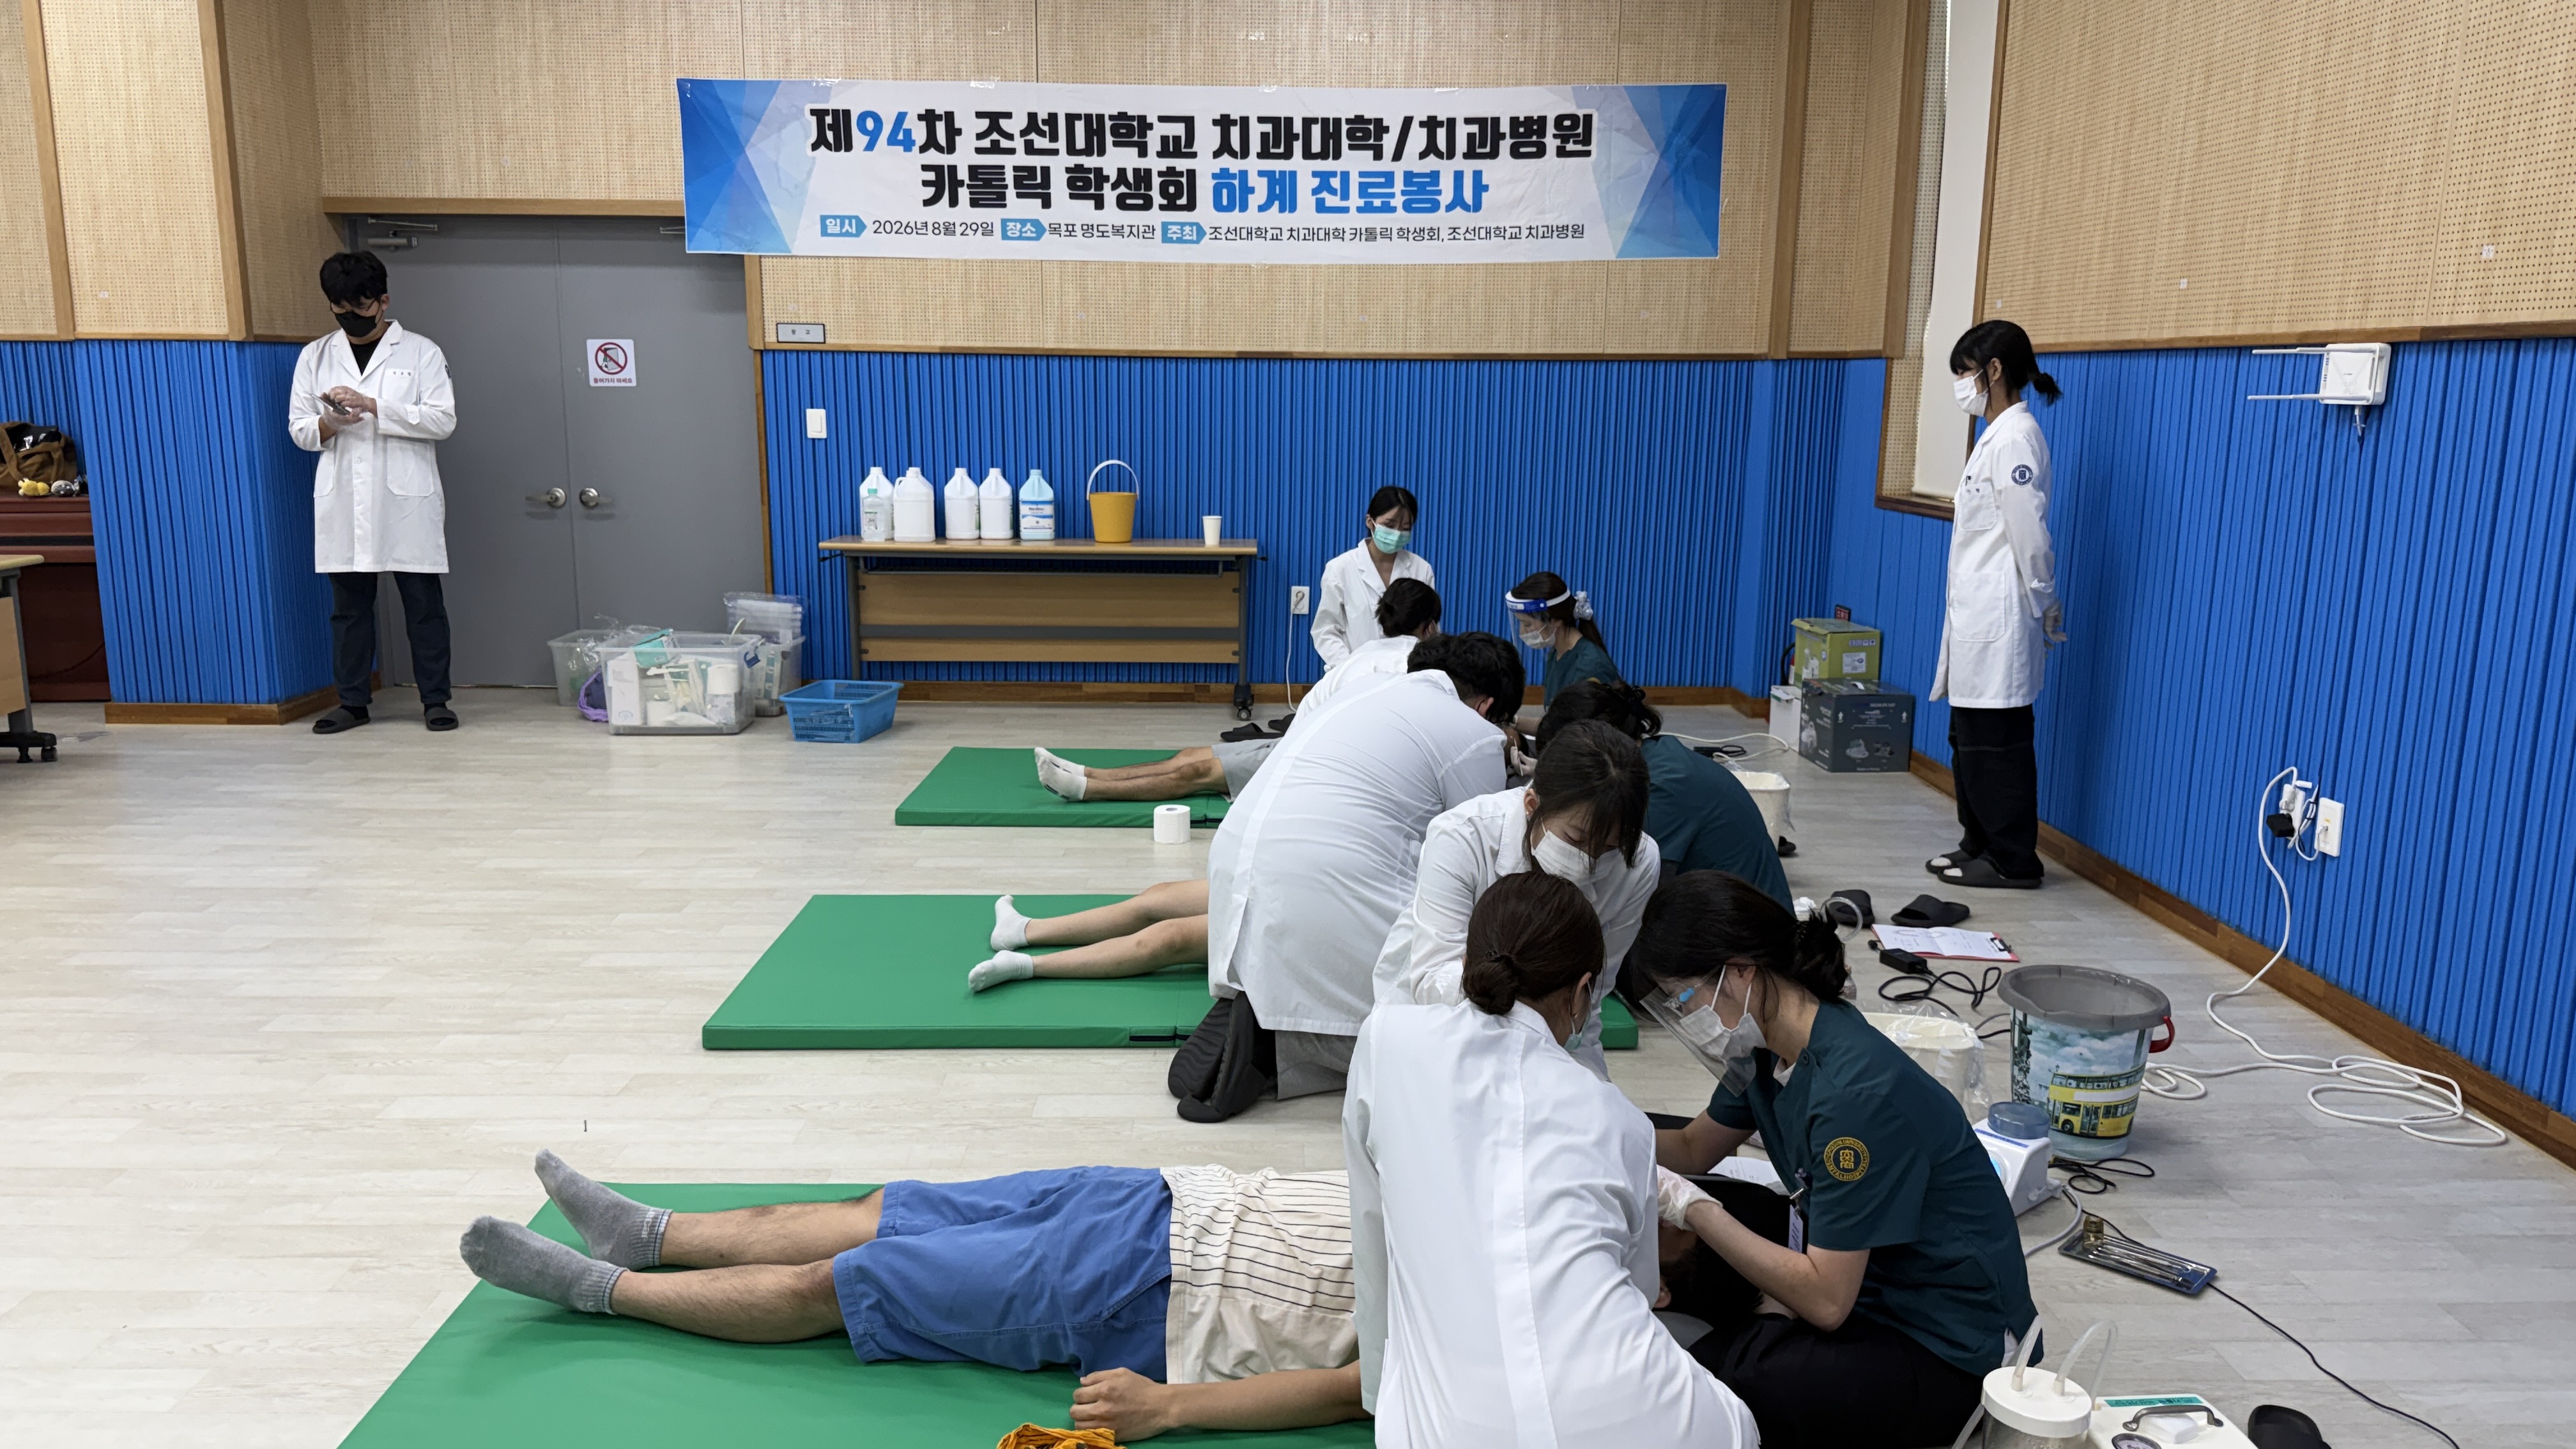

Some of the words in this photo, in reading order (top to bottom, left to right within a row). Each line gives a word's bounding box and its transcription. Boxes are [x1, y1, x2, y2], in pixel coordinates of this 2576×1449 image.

[810, 109, 962, 155] 제94차
[975, 111, 1197, 158] 조선대학교
[1212, 114, 1593, 162] 치과대학/치과병원
[921, 165, 1051, 209] 카톨릭
[1065, 164, 1197, 211] 학생회
[1212, 168, 1297, 213] 하계
[1312, 170, 1489, 213] 진료봉사
[825, 219, 856, 234] 일시
[873, 220, 928, 236] 2026년
[931, 221, 956, 236] 8월
[960, 222, 993, 236] 29일
[1006, 222, 1036, 237] 장소
[1048, 223, 1078, 238] 목포
[1081, 224, 1156, 240] 명도복지관
[1167, 225, 1197, 241] 주최
[1209, 226, 1284, 241] 조선대학교
[1287, 227, 1346, 242] 치과대학
[1349, 227, 1392, 242] 카톨릭
[1396, 227, 1444, 243] 학생회,
[1448, 226, 1522, 241] 조선대학교
[1525, 224, 1584, 240] 치과병원
